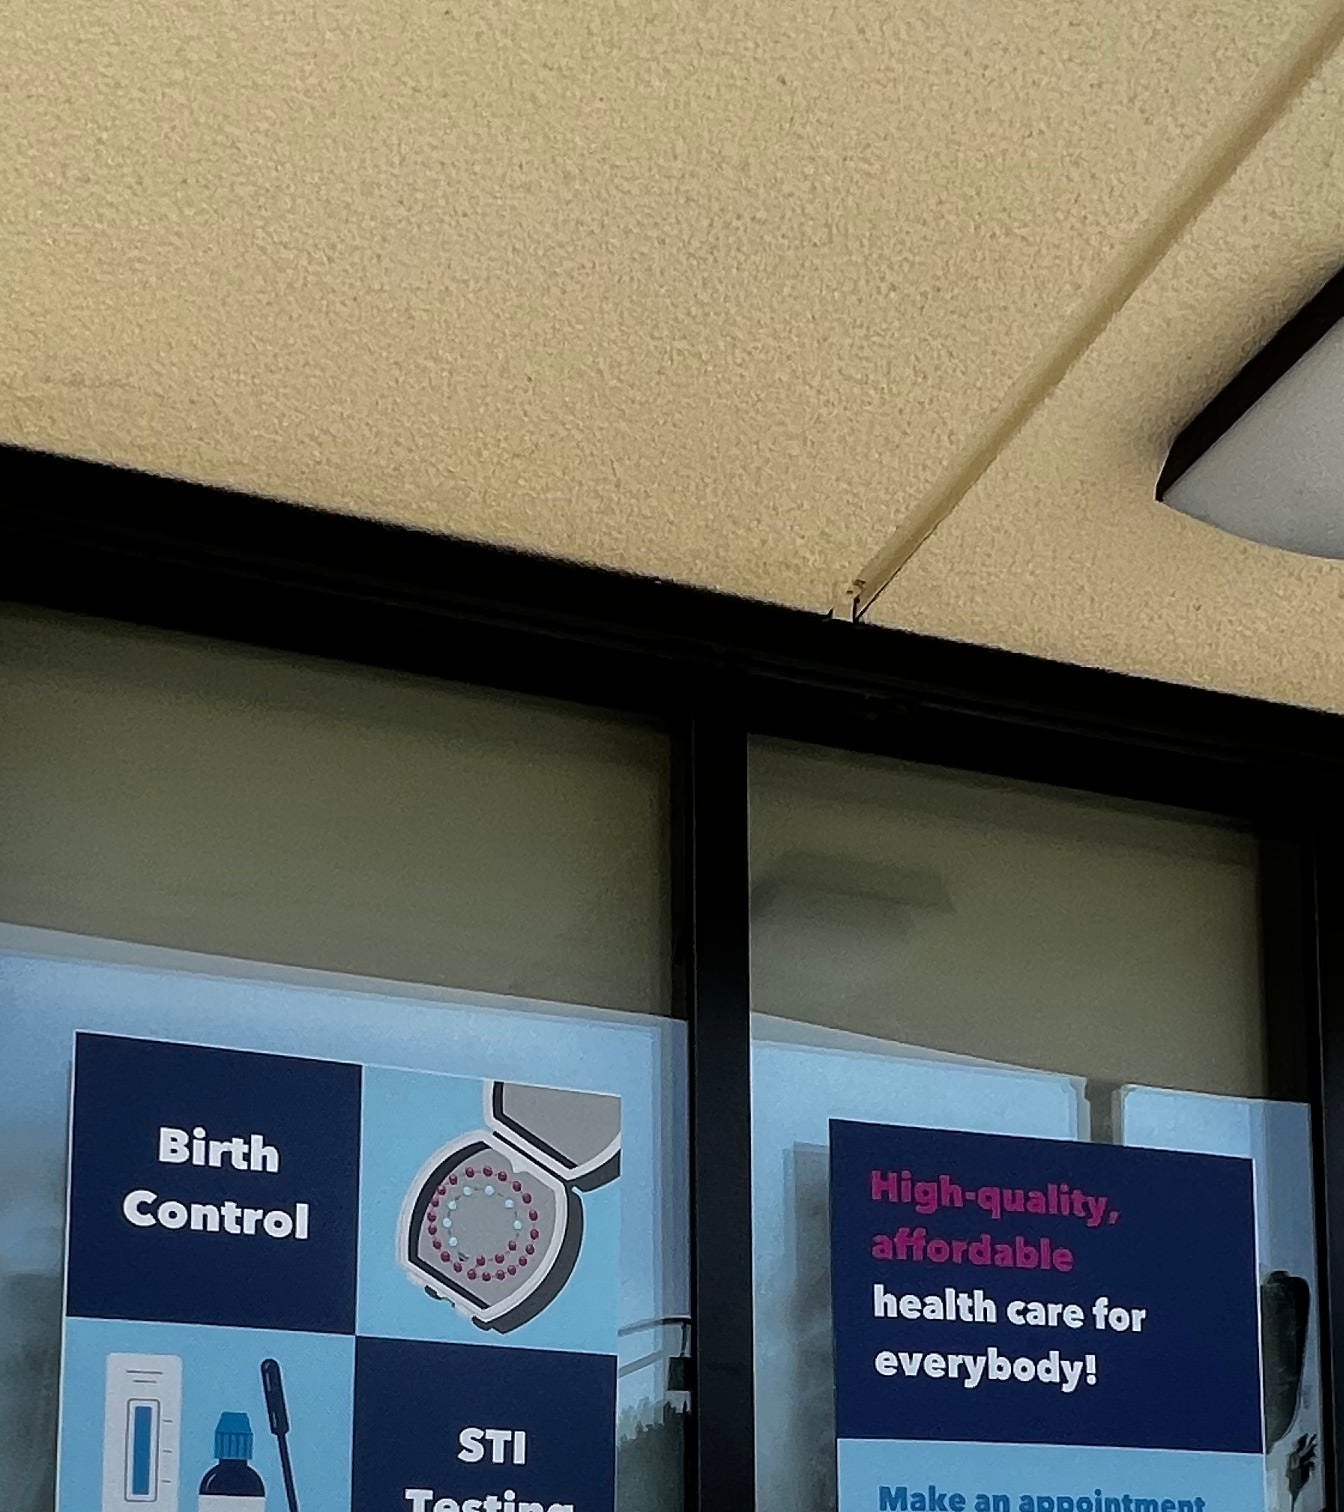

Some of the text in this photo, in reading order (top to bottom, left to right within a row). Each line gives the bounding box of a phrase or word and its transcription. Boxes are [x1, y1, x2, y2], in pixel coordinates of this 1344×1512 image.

[159, 1127, 279, 1174] Birth
[122, 1189, 309, 1240] Control
[871, 1170, 1120, 1228] High-quality,
[871, 1228, 1075, 1271] affordable
[873, 1284, 1146, 1332] health care for
[875, 1348, 1097, 1392] everybody!
[457, 1427, 526, 1466] STI
[878, 1486, 966, 1512] Make
